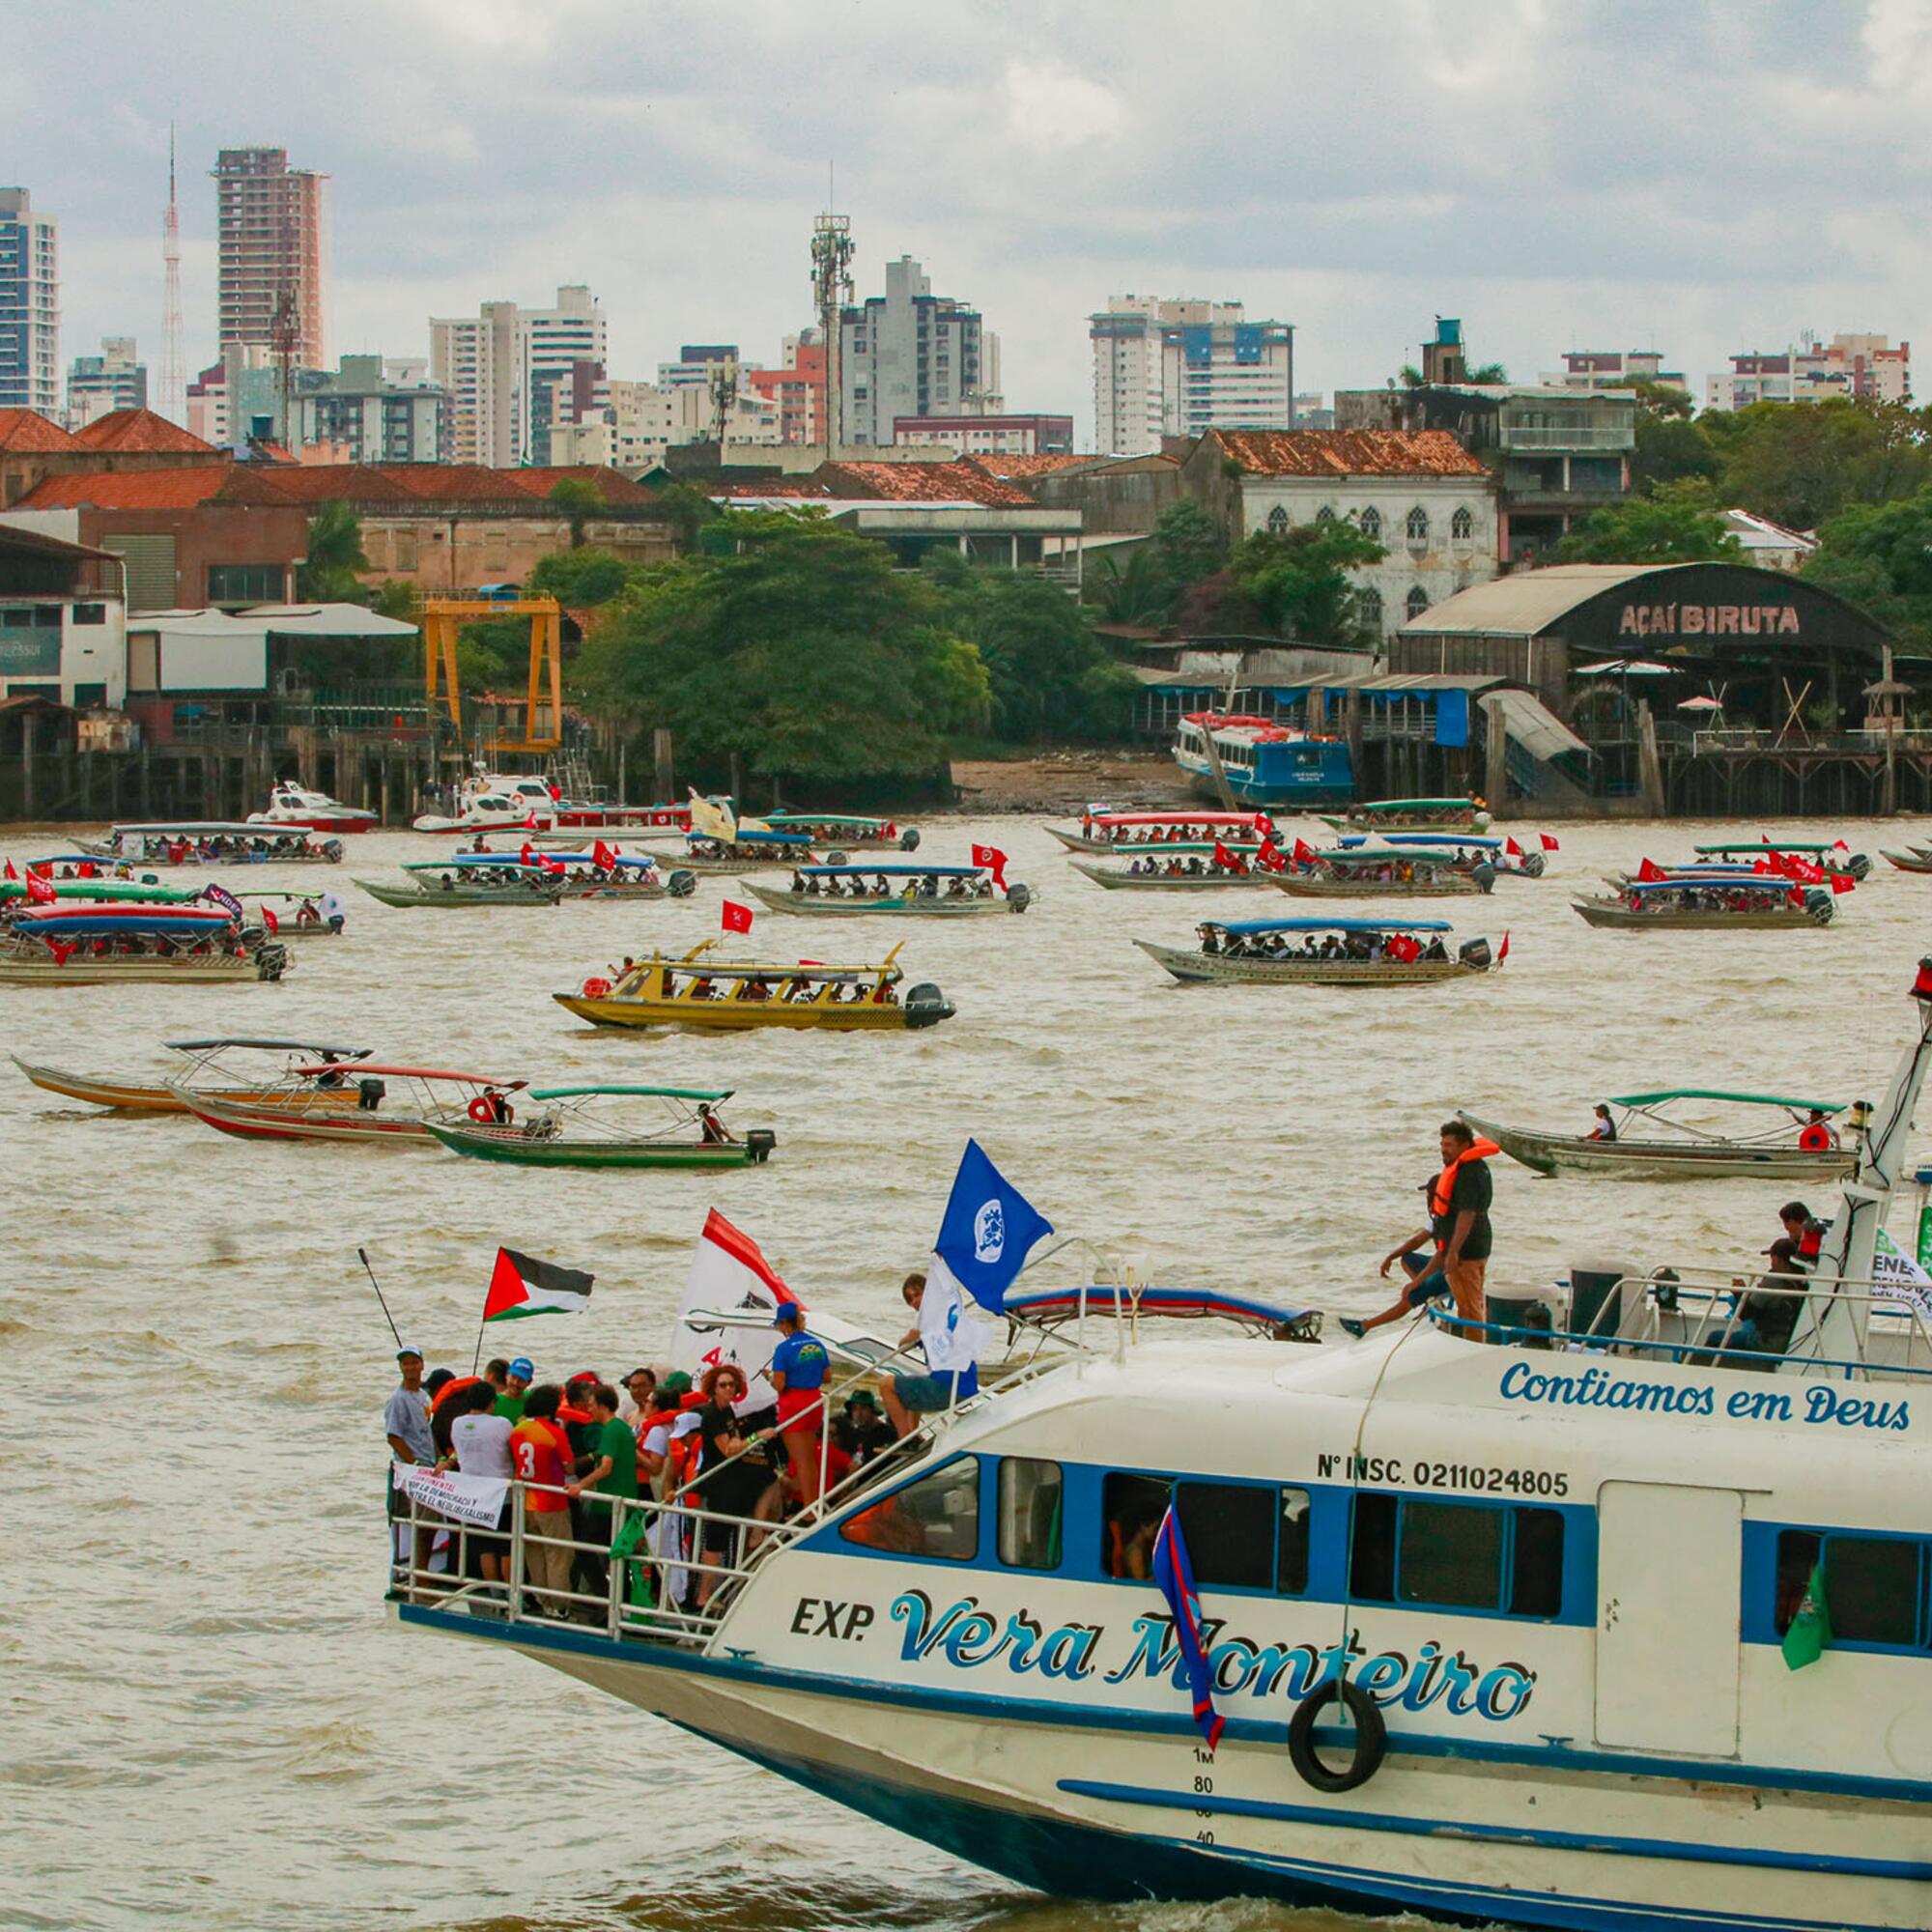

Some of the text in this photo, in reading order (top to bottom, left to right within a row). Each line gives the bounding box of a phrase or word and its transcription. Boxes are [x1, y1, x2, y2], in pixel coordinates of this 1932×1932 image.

[1619, 602, 1800, 638] AÇAÍ BIRUTA
[1499, 1361, 1911, 1431] Confiamos em Deus
[518, 1441, 535, 1479] 3
[1346, 1456, 1406, 1485] INSC.
[1413, 1462, 1569, 1497] 0211024805
[789, 1597, 875, 1642] EXP.
[889, 1589, 1104, 1681] Vera
[1193, 1776, 1213, 1793] 80
